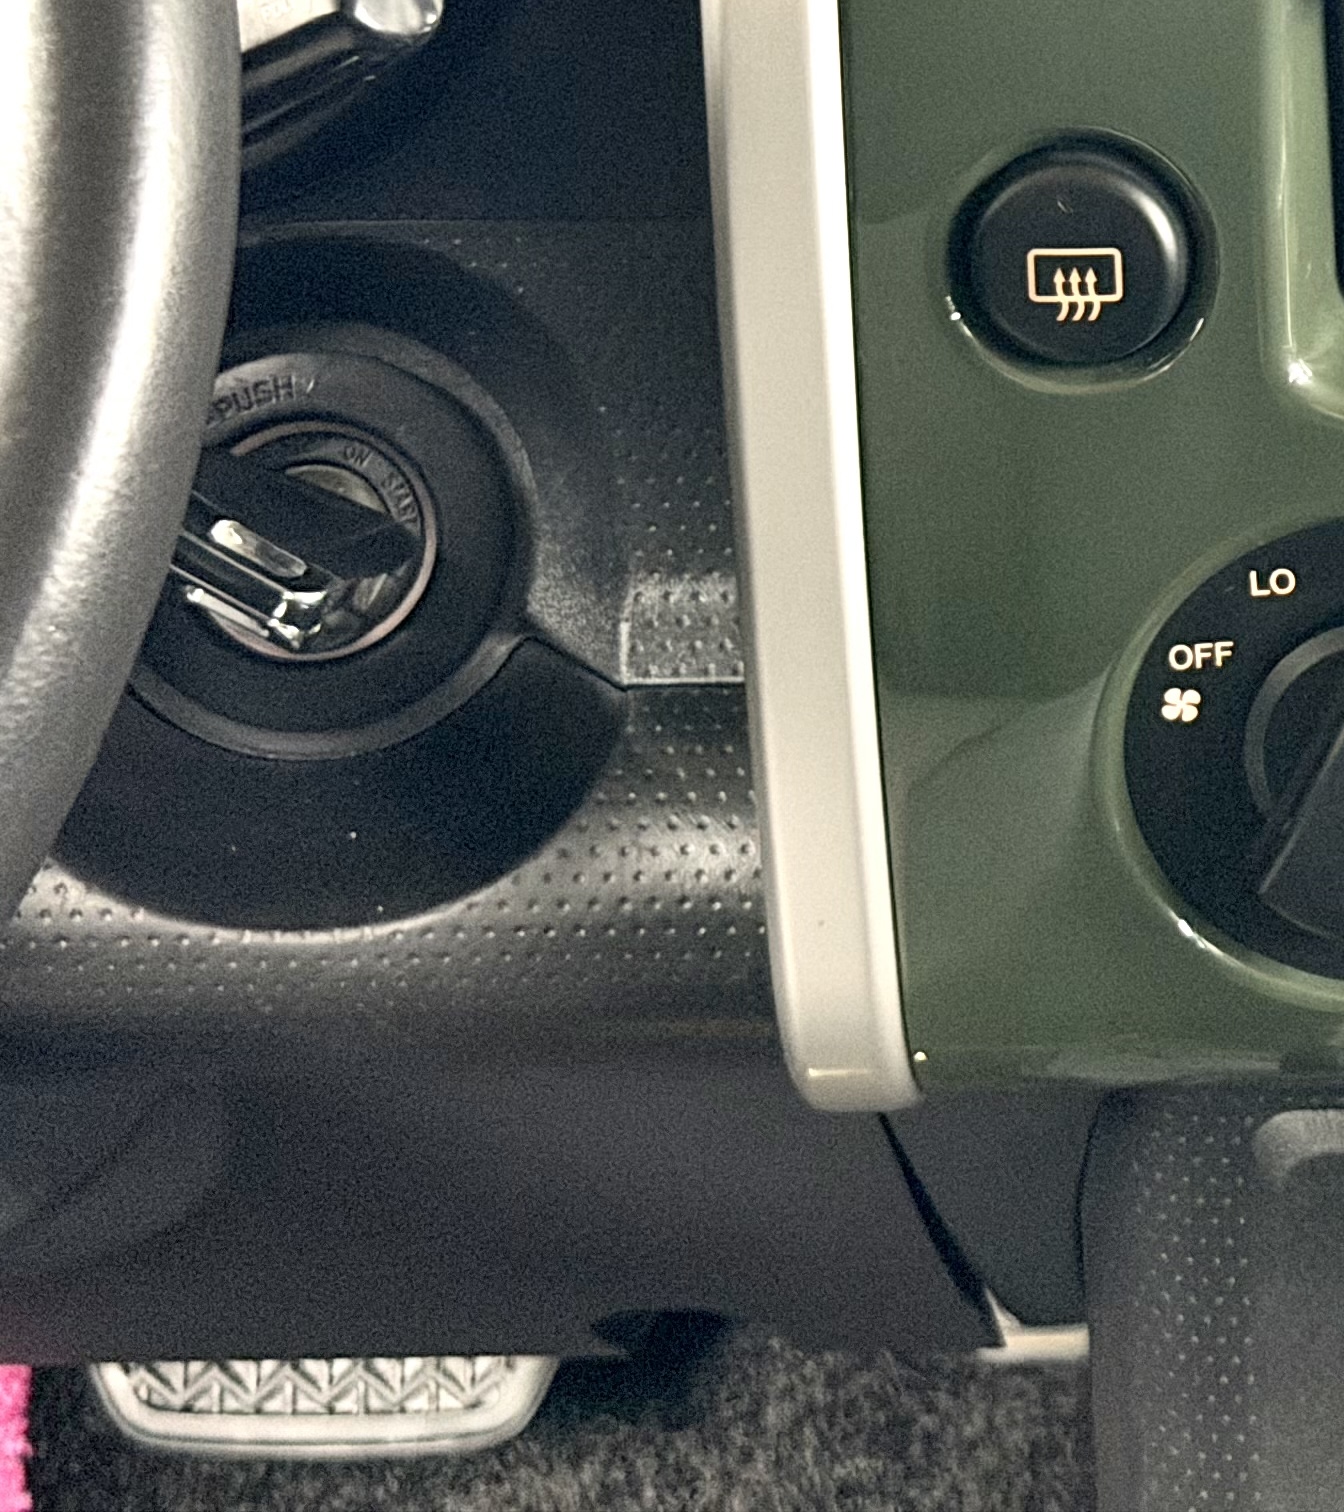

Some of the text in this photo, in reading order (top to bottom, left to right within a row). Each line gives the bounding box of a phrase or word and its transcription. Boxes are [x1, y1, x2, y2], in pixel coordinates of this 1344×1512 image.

[206, 374, 295, 426] PUSH
[1248, 568, 1297, 597] LO
[1168, 641, 1234, 670] OFF
